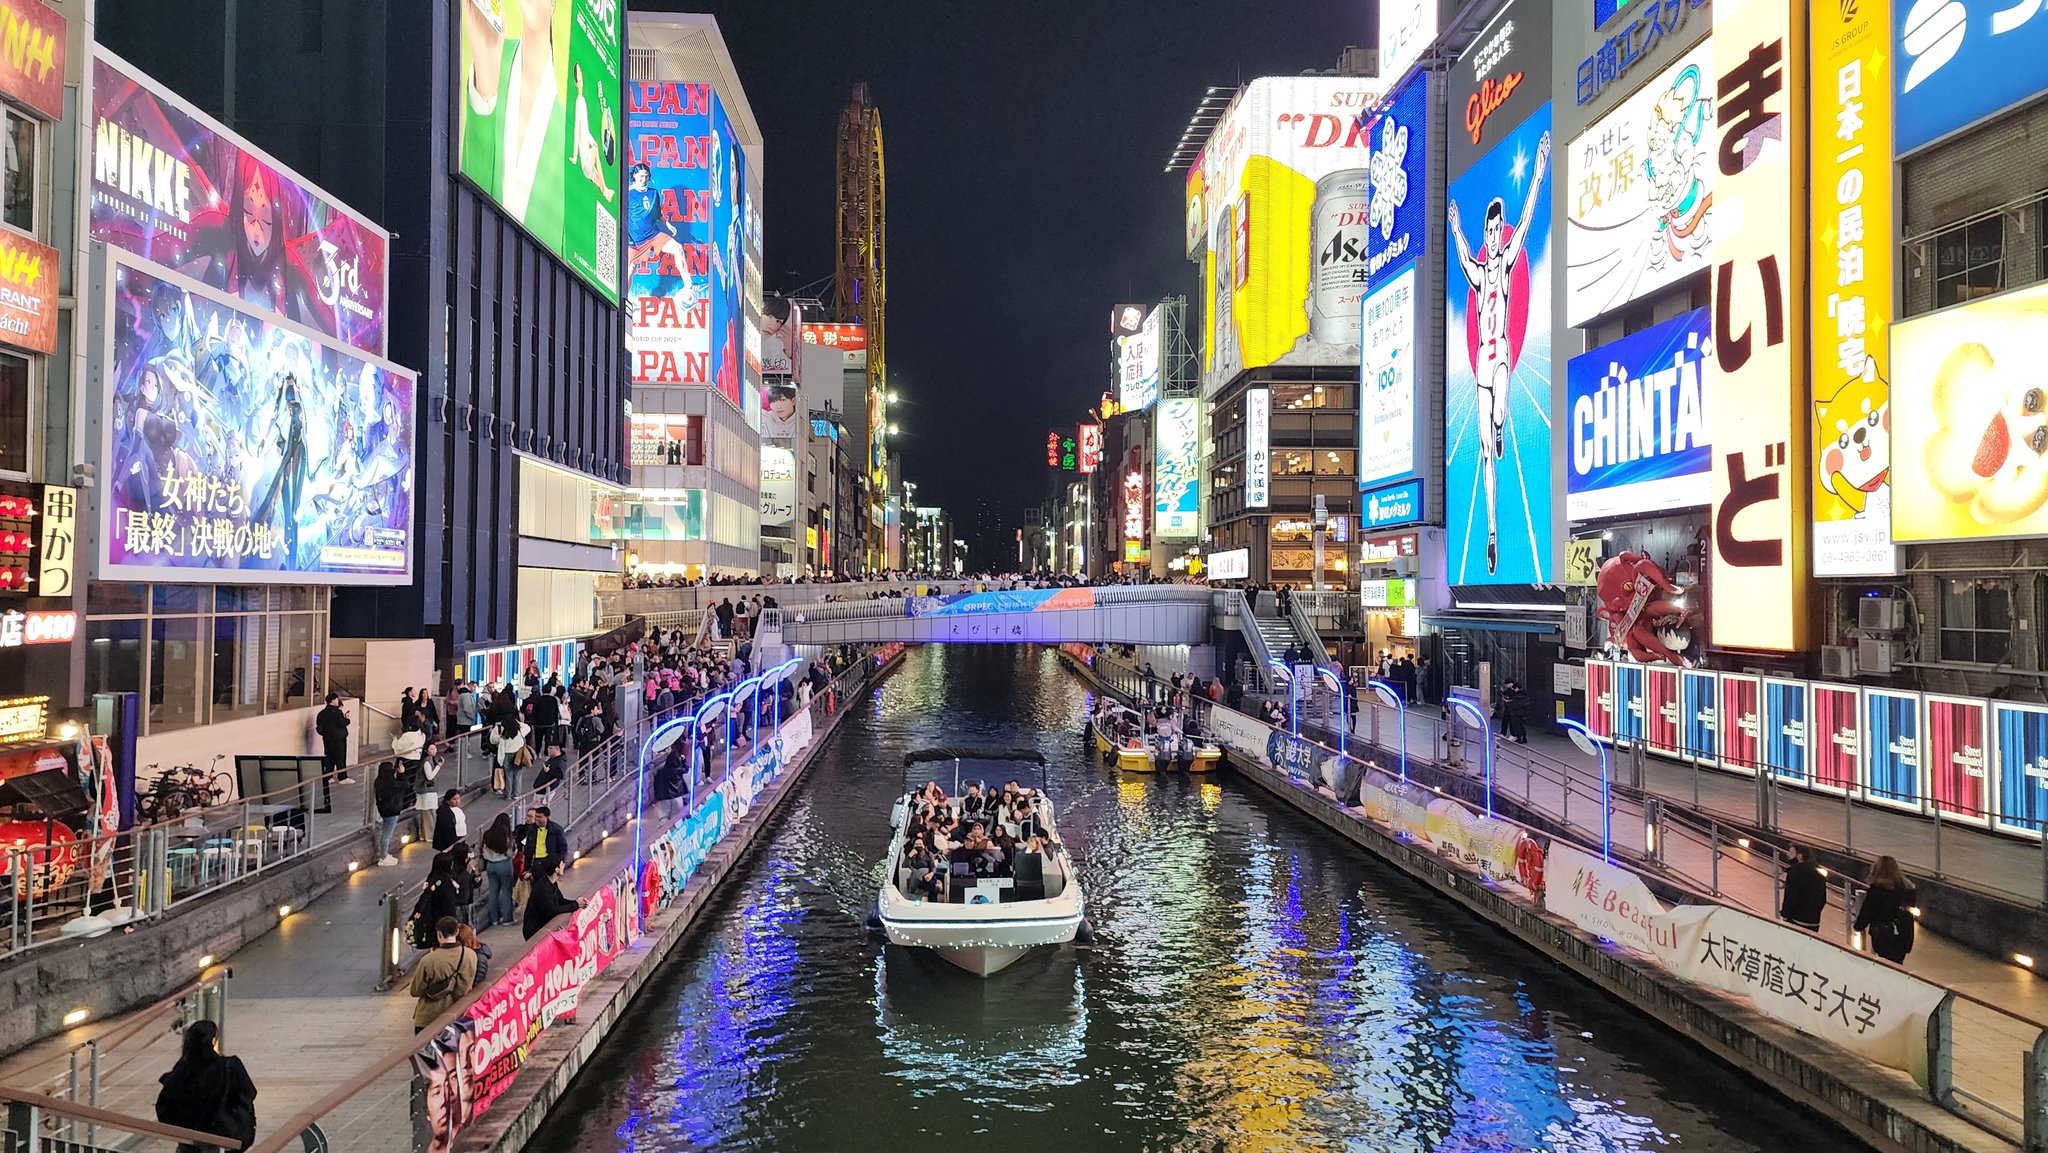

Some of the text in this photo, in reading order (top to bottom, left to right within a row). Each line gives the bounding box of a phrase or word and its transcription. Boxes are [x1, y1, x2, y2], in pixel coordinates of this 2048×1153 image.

[1841, 21, 1869, 44] GROUP
[1466, 71, 1522, 145] Glico
[96, 116, 190, 224] NIKKE
[1579, 148, 1634, 219] 改源
[316, 241, 360, 305] 3rd
[632, 296, 709, 328] PAN
[1368, 286, 1408, 327] 創業100周年
[1714, 37, 1786, 567] まいど
[802, 331, 838, 345] 免税
[632, 350, 710, 382] PAN
[160, 470, 251, 517] 女神たち、
[44, 490, 73, 594] 串かつ
[116, 507, 290, 560] 「最終」決戦の地へ
[1823, 529, 1886, 545] www.jsv.jp
[952, 624, 1022, 636] えびす橋
[1900, 735, 1915, 747] Street
[1953, 752, 1982, 766] Illuminated
[1965, 744, 1981, 757] Street
[1900, 755, 1916, 766] Panels
[1966, 766, 1984, 778] Panels
[1701, 931, 1881, 1034] 大阪樟蔭女子大学
[474, 1018, 519, 1075] Oaka
